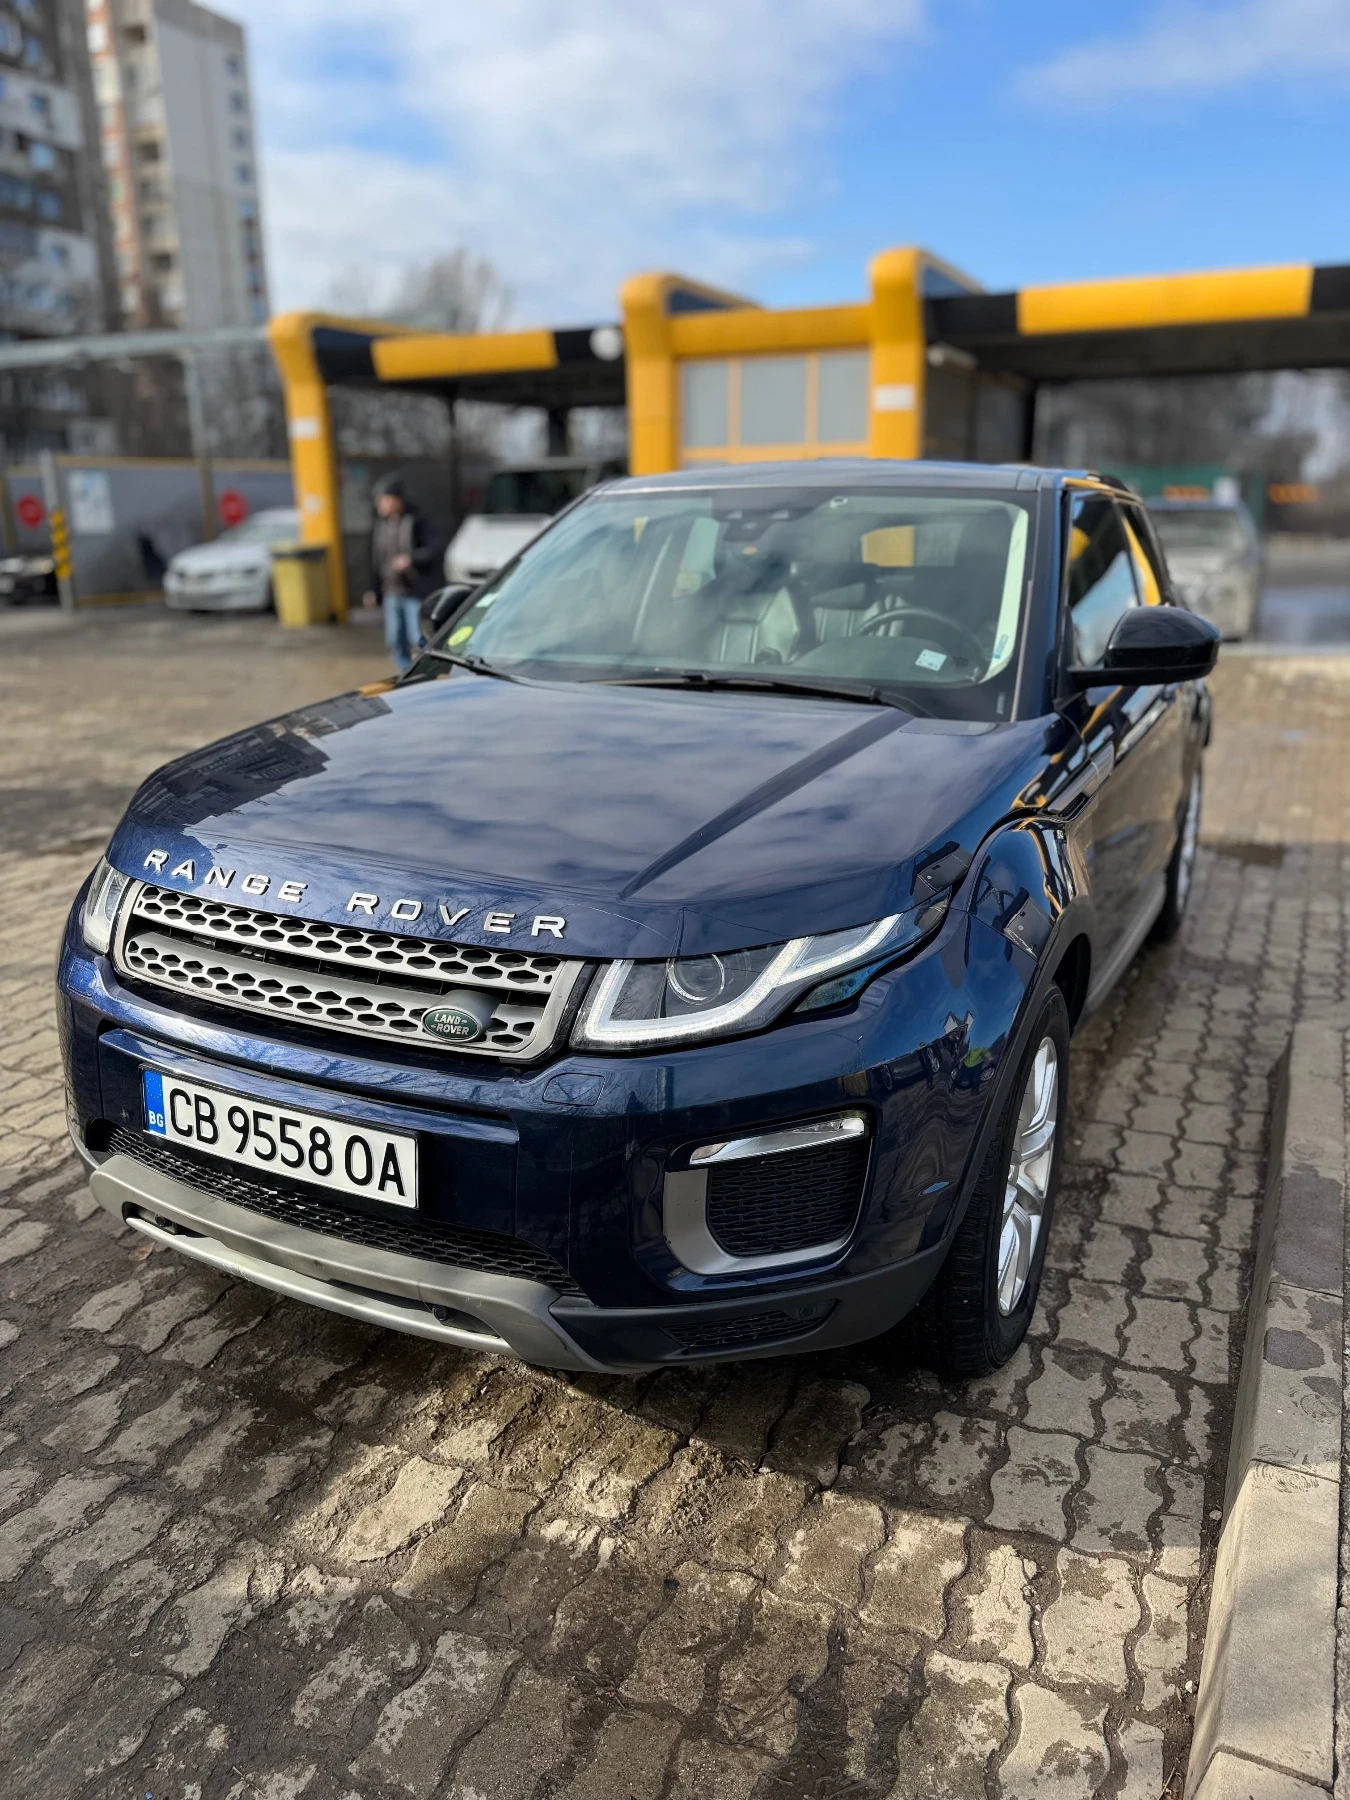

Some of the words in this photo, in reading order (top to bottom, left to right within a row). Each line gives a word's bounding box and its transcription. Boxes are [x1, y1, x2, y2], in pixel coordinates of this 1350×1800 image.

[143, 849, 307, 903] RANGE
[348, 893, 567, 939] ROVER
[149, 1109, 164, 1128] BG
[169, 1088, 219, 1145] CB
[227, 1105, 334, 1177] 9558
